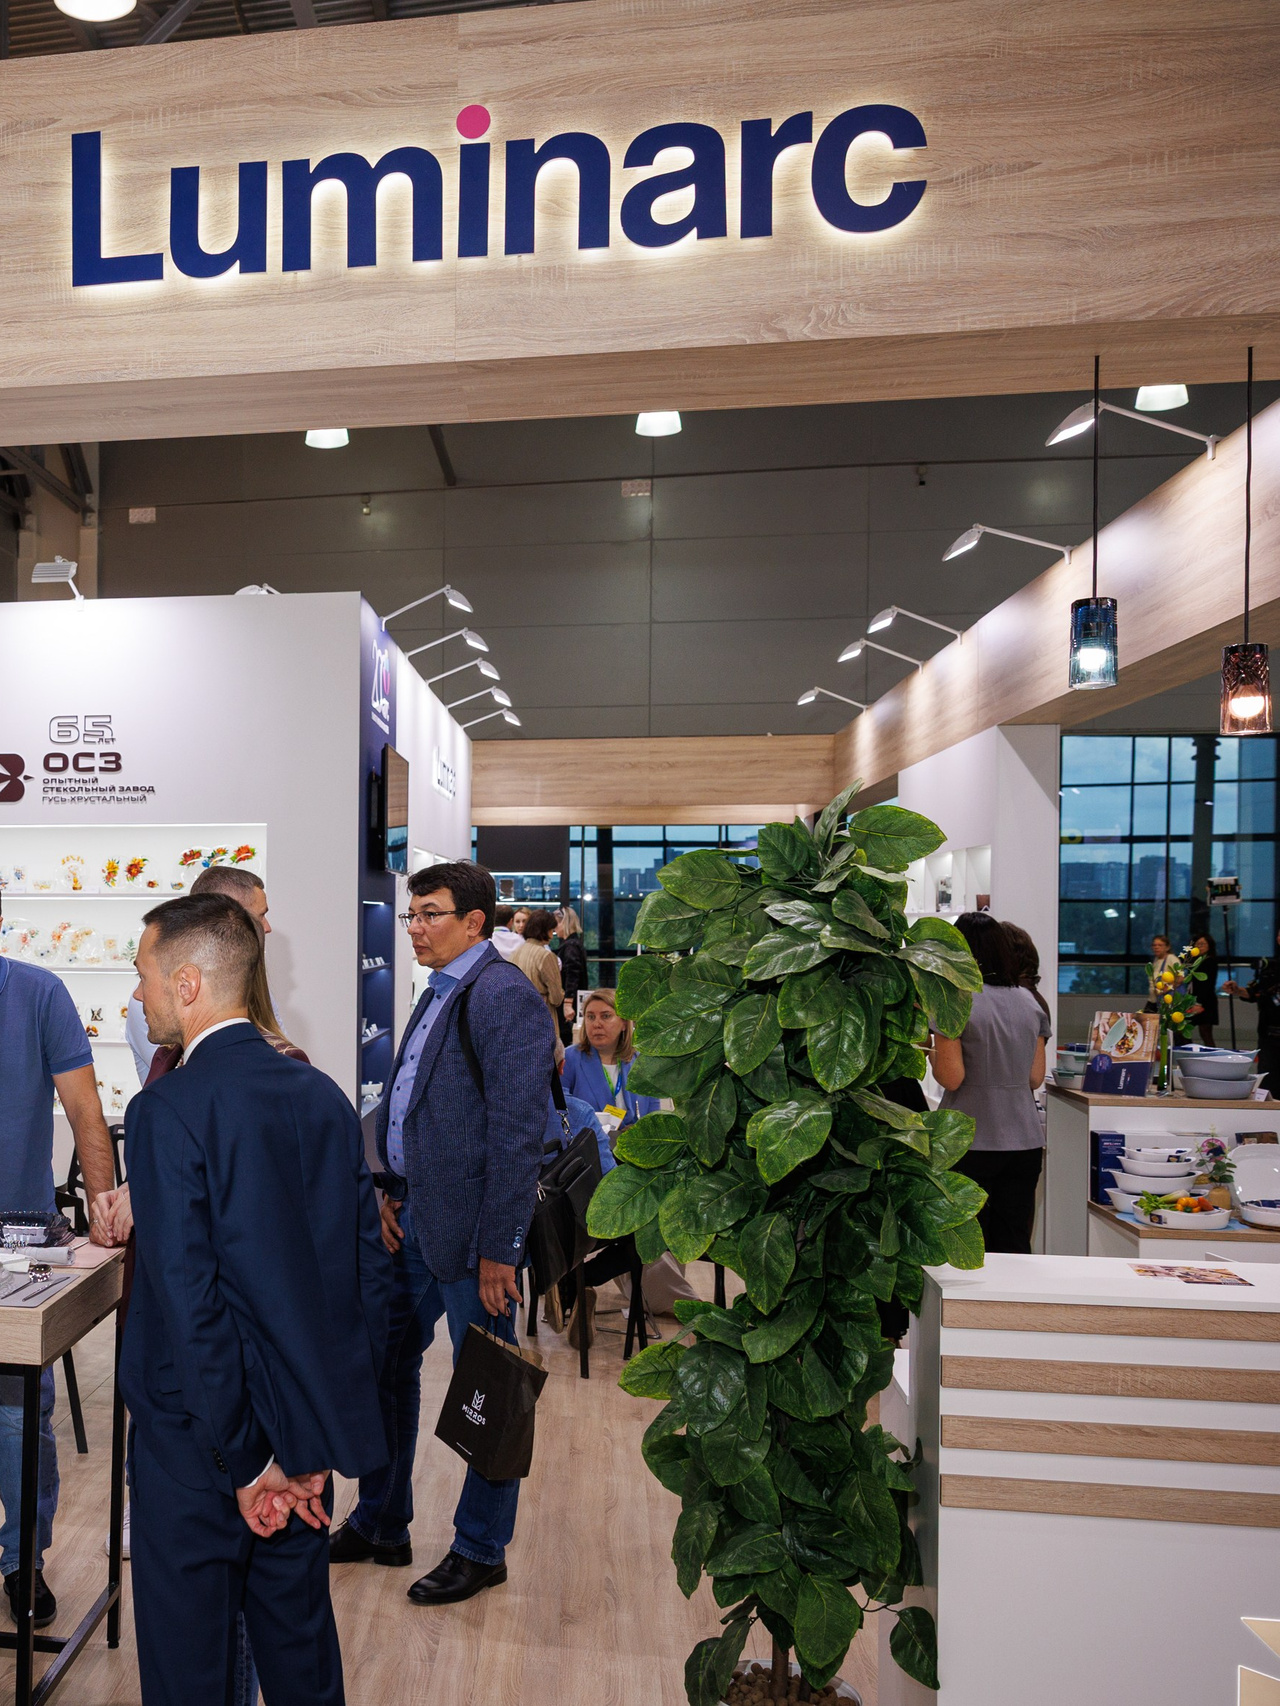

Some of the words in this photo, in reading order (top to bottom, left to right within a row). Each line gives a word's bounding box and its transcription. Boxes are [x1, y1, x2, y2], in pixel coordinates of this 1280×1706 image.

[71, 104, 928, 288] Luminarc
[48, 714, 114, 744] 65
[42, 751, 123, 773] ОСЗ
[42, 776, 99, 785] ОПЫТНЫЙ
[42, 785, 116, 793] СТЕКОЛЬНЫЙ
[118, 785, 155, 794] ЗАВОД
[41, 795, 147, 803] ГУСЬ-ХРУСТАЛЬНЫЙ
